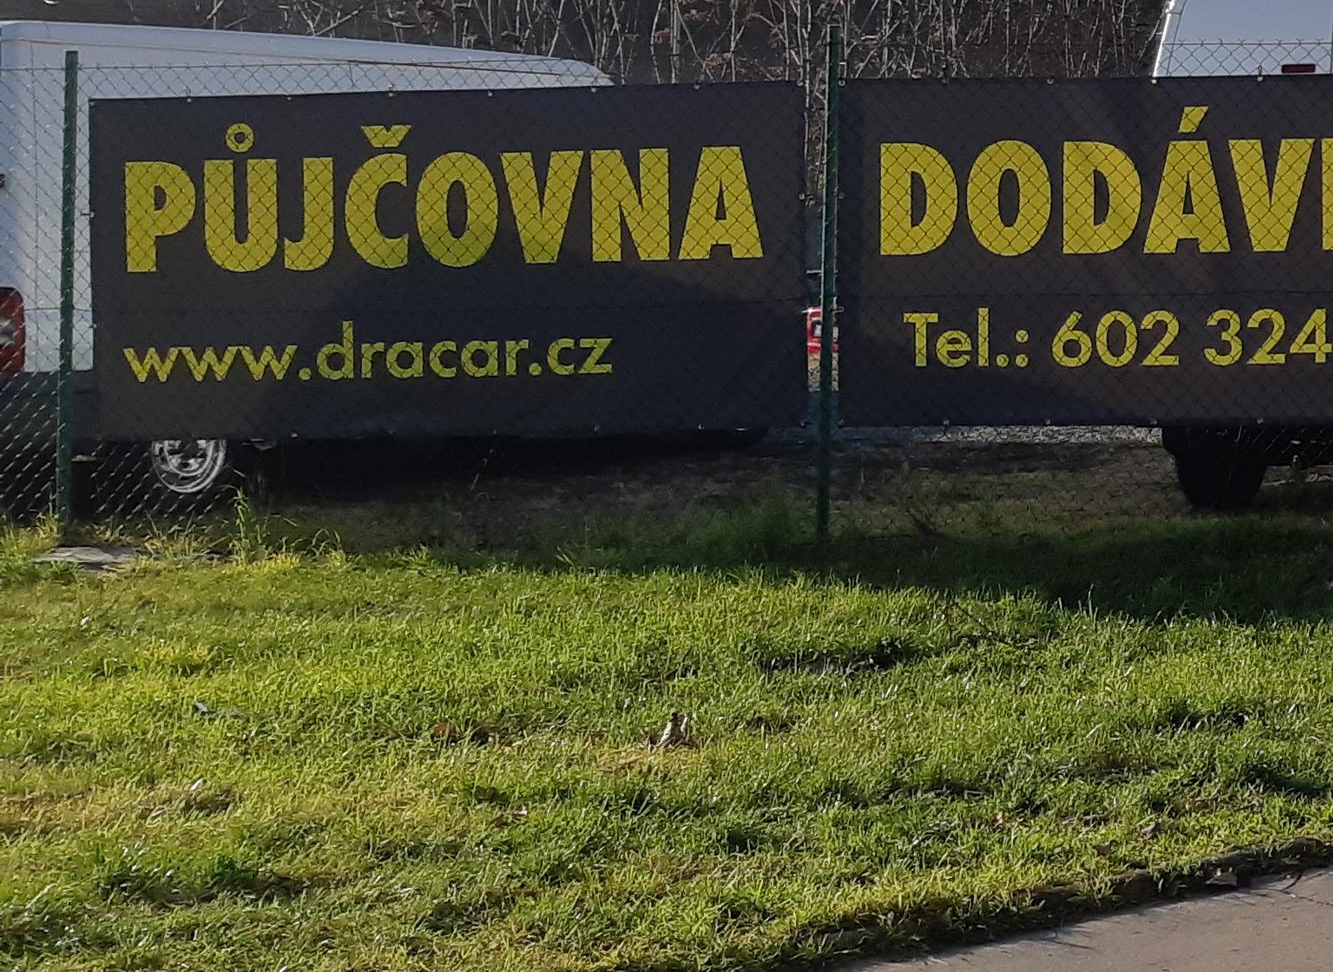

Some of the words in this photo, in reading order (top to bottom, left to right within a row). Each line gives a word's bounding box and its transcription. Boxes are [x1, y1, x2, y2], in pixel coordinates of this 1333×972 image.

[124, 122, 764, 273] PŮJČOVNA
[123, 320, 613, 383] www.dracar.cz
[903, 307, 1029, 369] Tel.:
[1051, 310, 1181, 367] 602
[1204, 308, 1333, 366] 324
